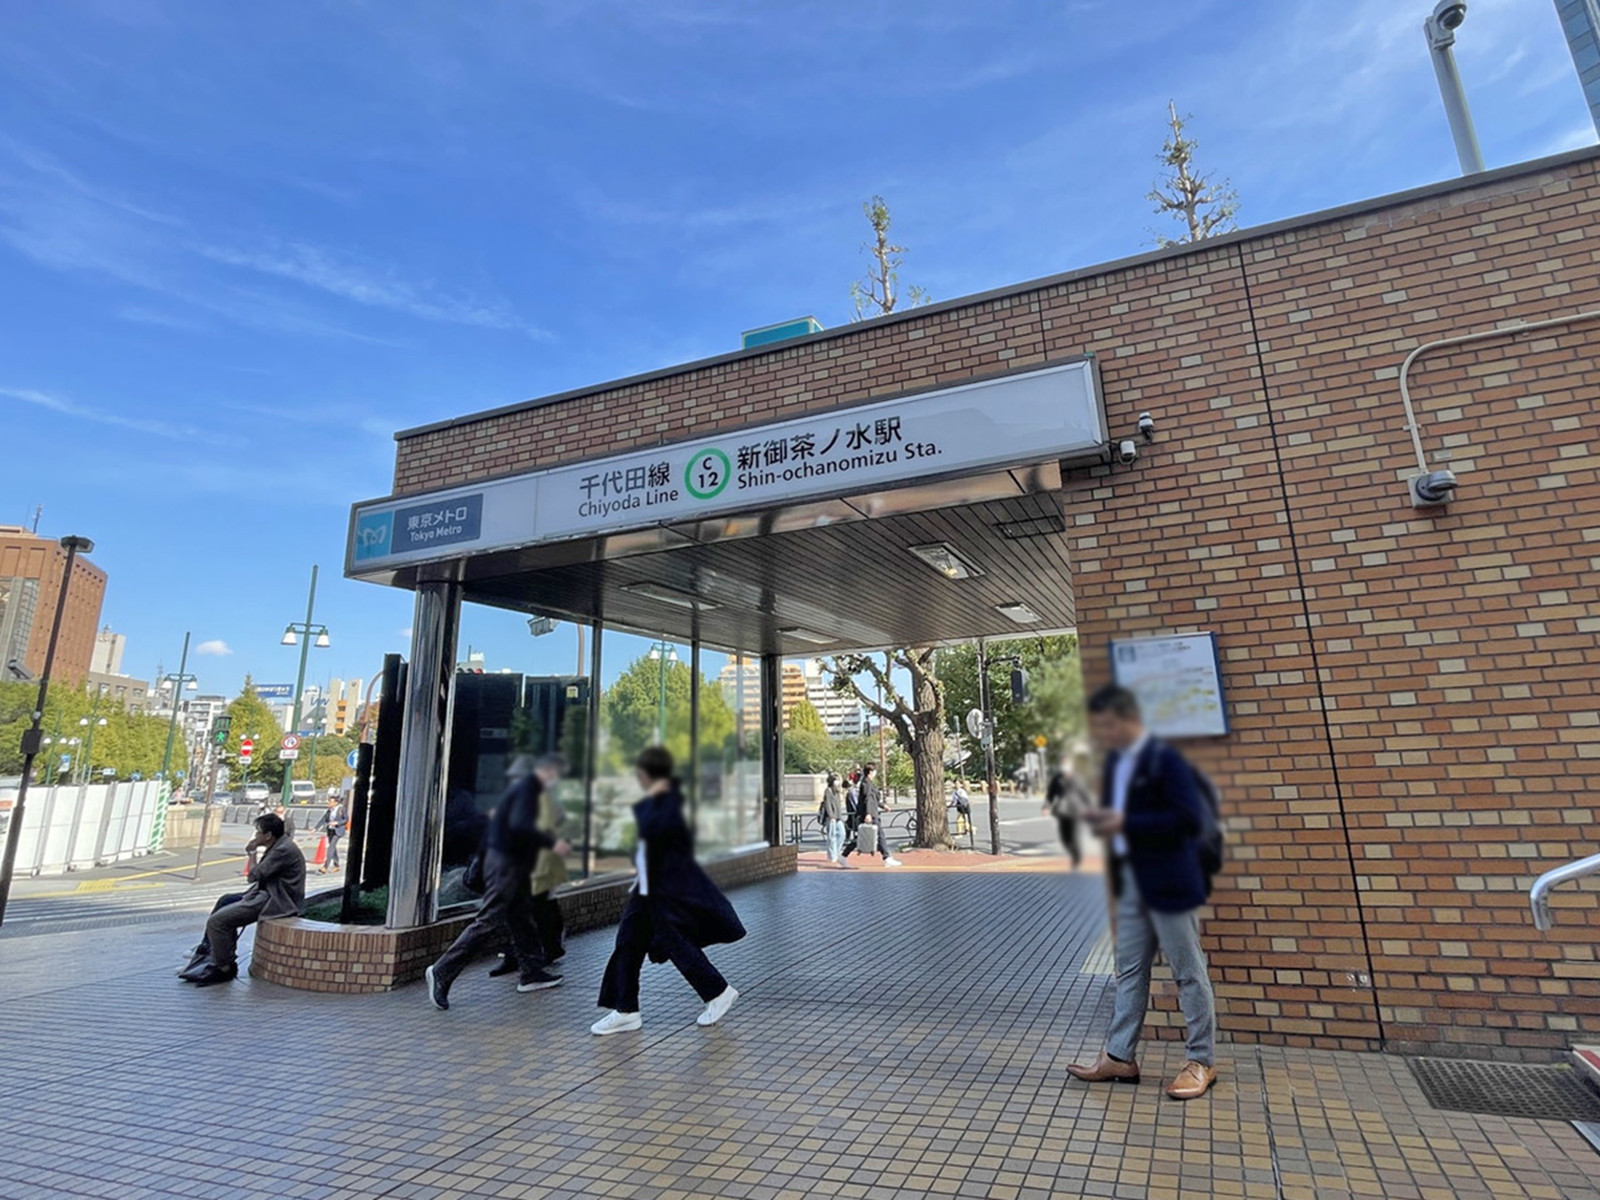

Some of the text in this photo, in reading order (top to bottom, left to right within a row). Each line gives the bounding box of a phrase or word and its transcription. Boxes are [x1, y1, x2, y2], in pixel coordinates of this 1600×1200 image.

[737, 416, 902, 471] 新御茶ノ水駅
[702, 457, 713, 470] C
[737, 442, 943, 489] Shin-ochanomizu Sta.
[579, 461, 671, 499] 千代田線
[698, 471, 719, 488] 12
[578, 489, 679, 518] Chiyoda Line
[407, 506, 467, 531] 東京メトロ
[410, 525, 462, 543] Tokyo Metro
